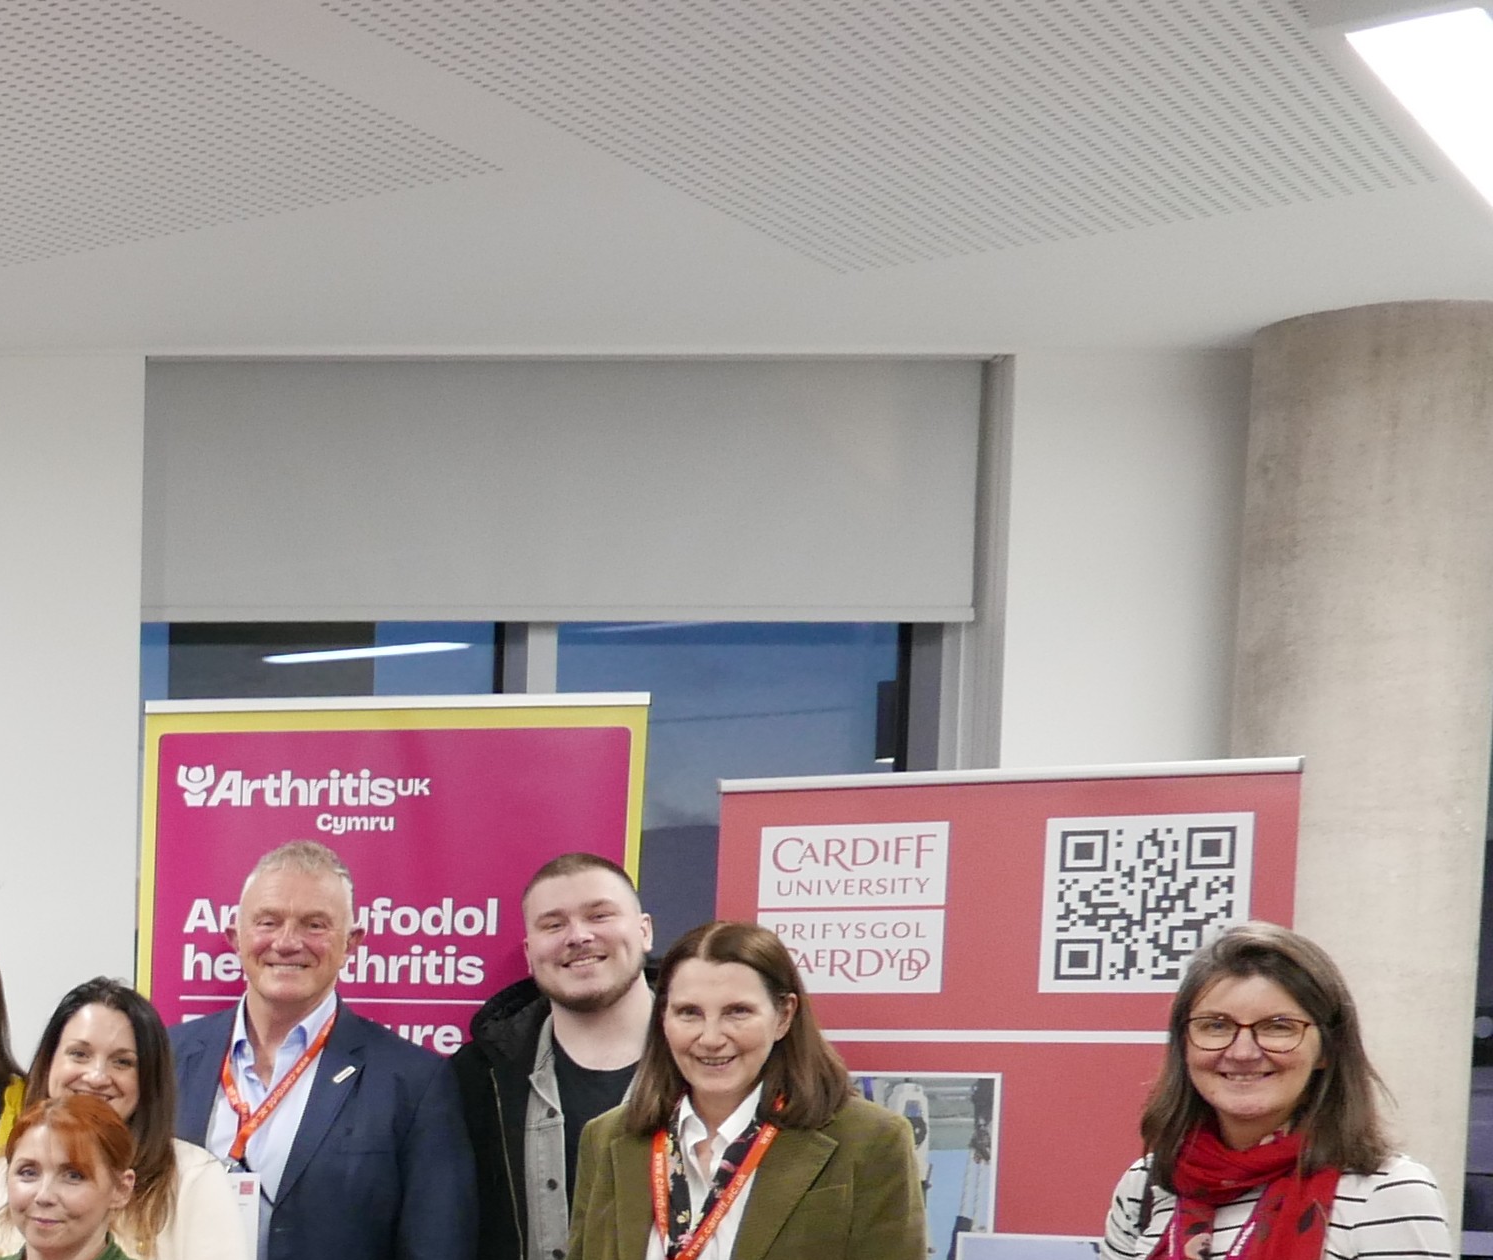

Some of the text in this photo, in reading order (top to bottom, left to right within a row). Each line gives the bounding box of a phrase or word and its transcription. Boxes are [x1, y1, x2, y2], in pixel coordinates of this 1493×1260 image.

[207, 769, 431, 807] Arthritis UK
[316, 813, 395, 835] Cymru
[772, 834, 937, 873] CARDIFF
[777, 877, 930, 897] UNIVERSITY
[775, 921, 927, 941] PRIFYSGOL
[183, 943, 251, 982] he
